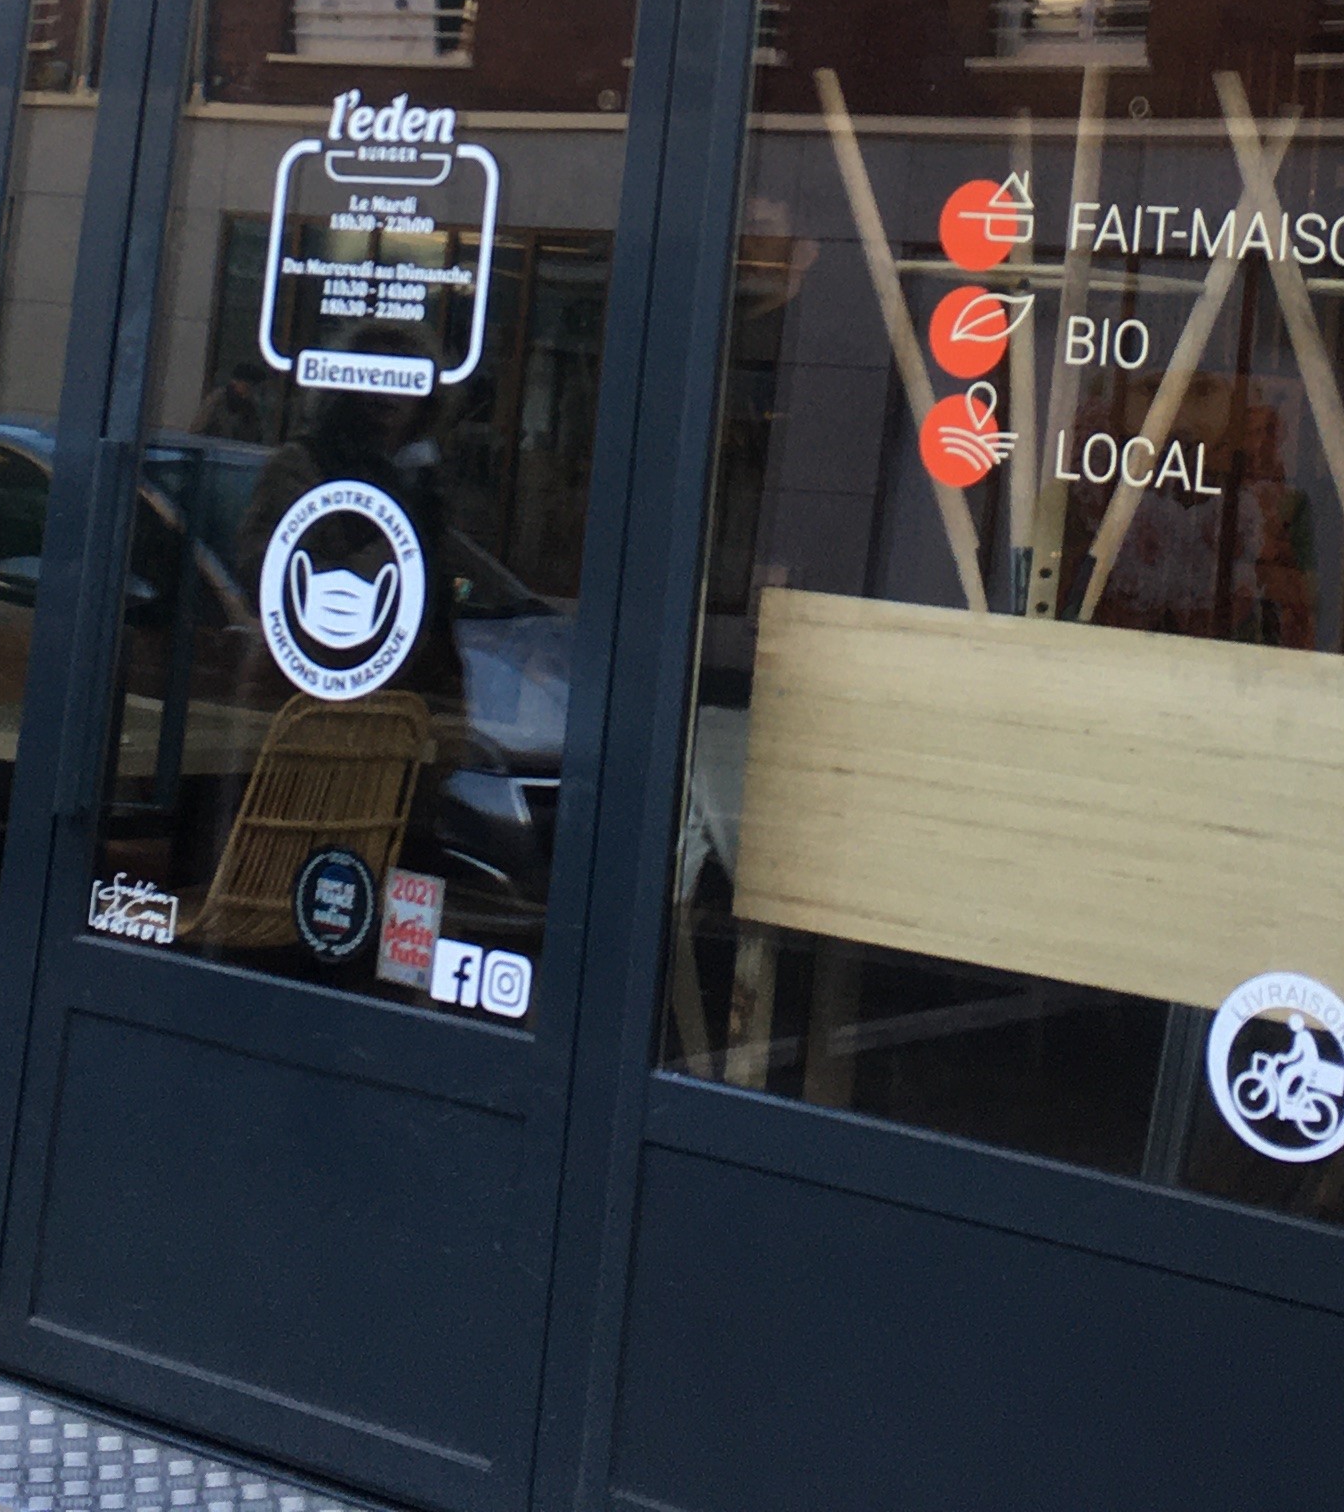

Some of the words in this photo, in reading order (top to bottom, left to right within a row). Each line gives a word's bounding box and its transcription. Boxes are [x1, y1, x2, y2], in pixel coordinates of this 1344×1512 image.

[328, 89, 456, 144] l'eden
[1064, 315, 1150, 370] BIO
[303, 357, 427, 389] Bienvenue
[1055, 429, 1222, 495] LOCAL
[280, 502, 318, 544] POUR
[321, 491, 375, 510] NOTRE
[375, 504, 419, 562] SANTÉ
[269, 610, 319, 686] PORTONS
[323, 675, 346, 691] UN
[350, 626, 408, 688] MASQUE
[391, 874, 438, 907] 2021
